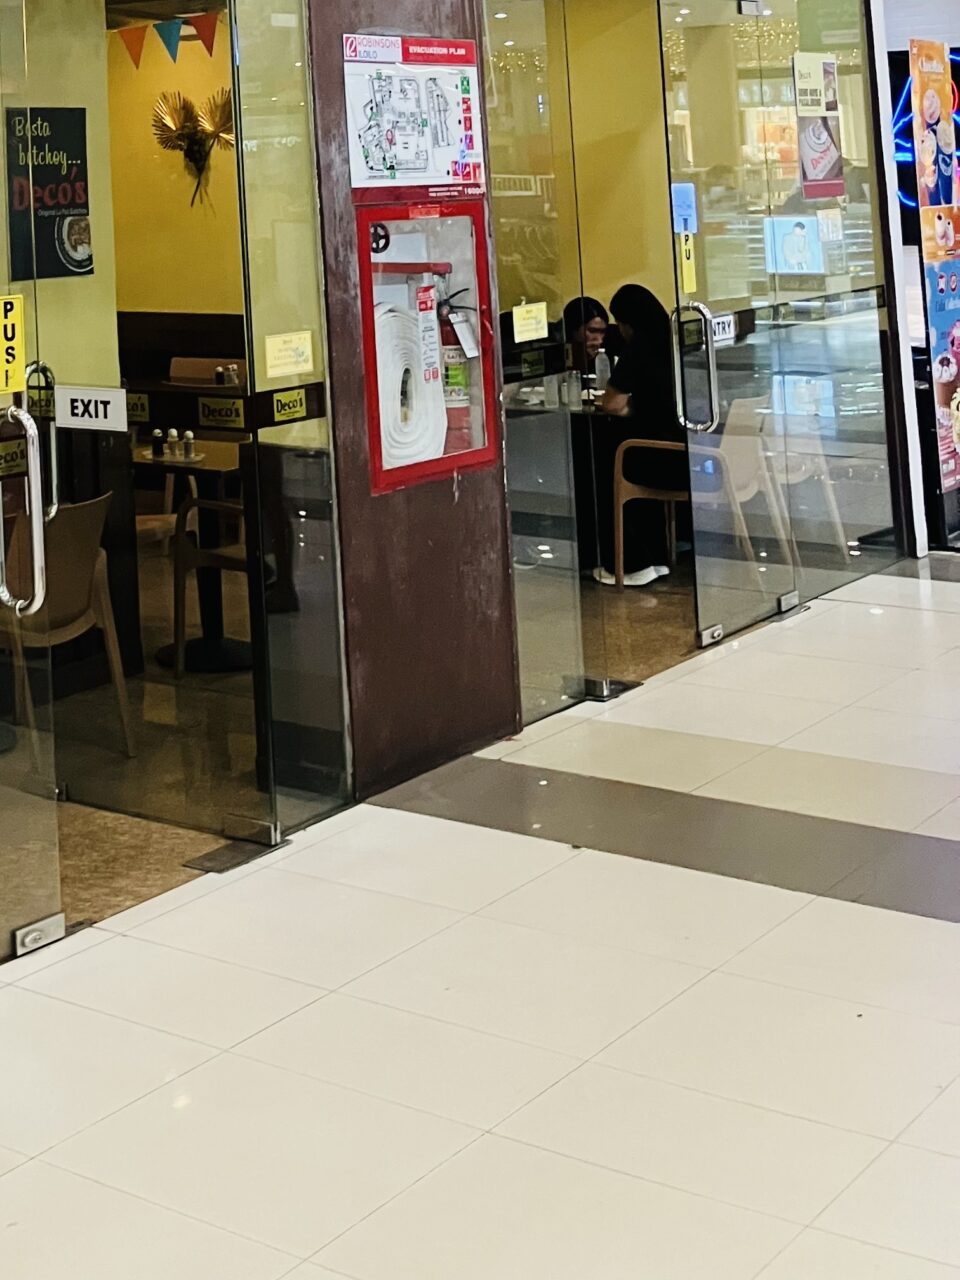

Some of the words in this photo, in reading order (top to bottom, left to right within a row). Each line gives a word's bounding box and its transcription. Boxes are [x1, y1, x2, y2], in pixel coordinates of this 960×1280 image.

[357, 37, 400, 49] ROBINSONS
[713, 319, 732, 337] NTRY
[69, 398, 111, 419] EXIT
[201, 401, 240, 418] Deco's
[276, 392, 303, 414] Deco's
